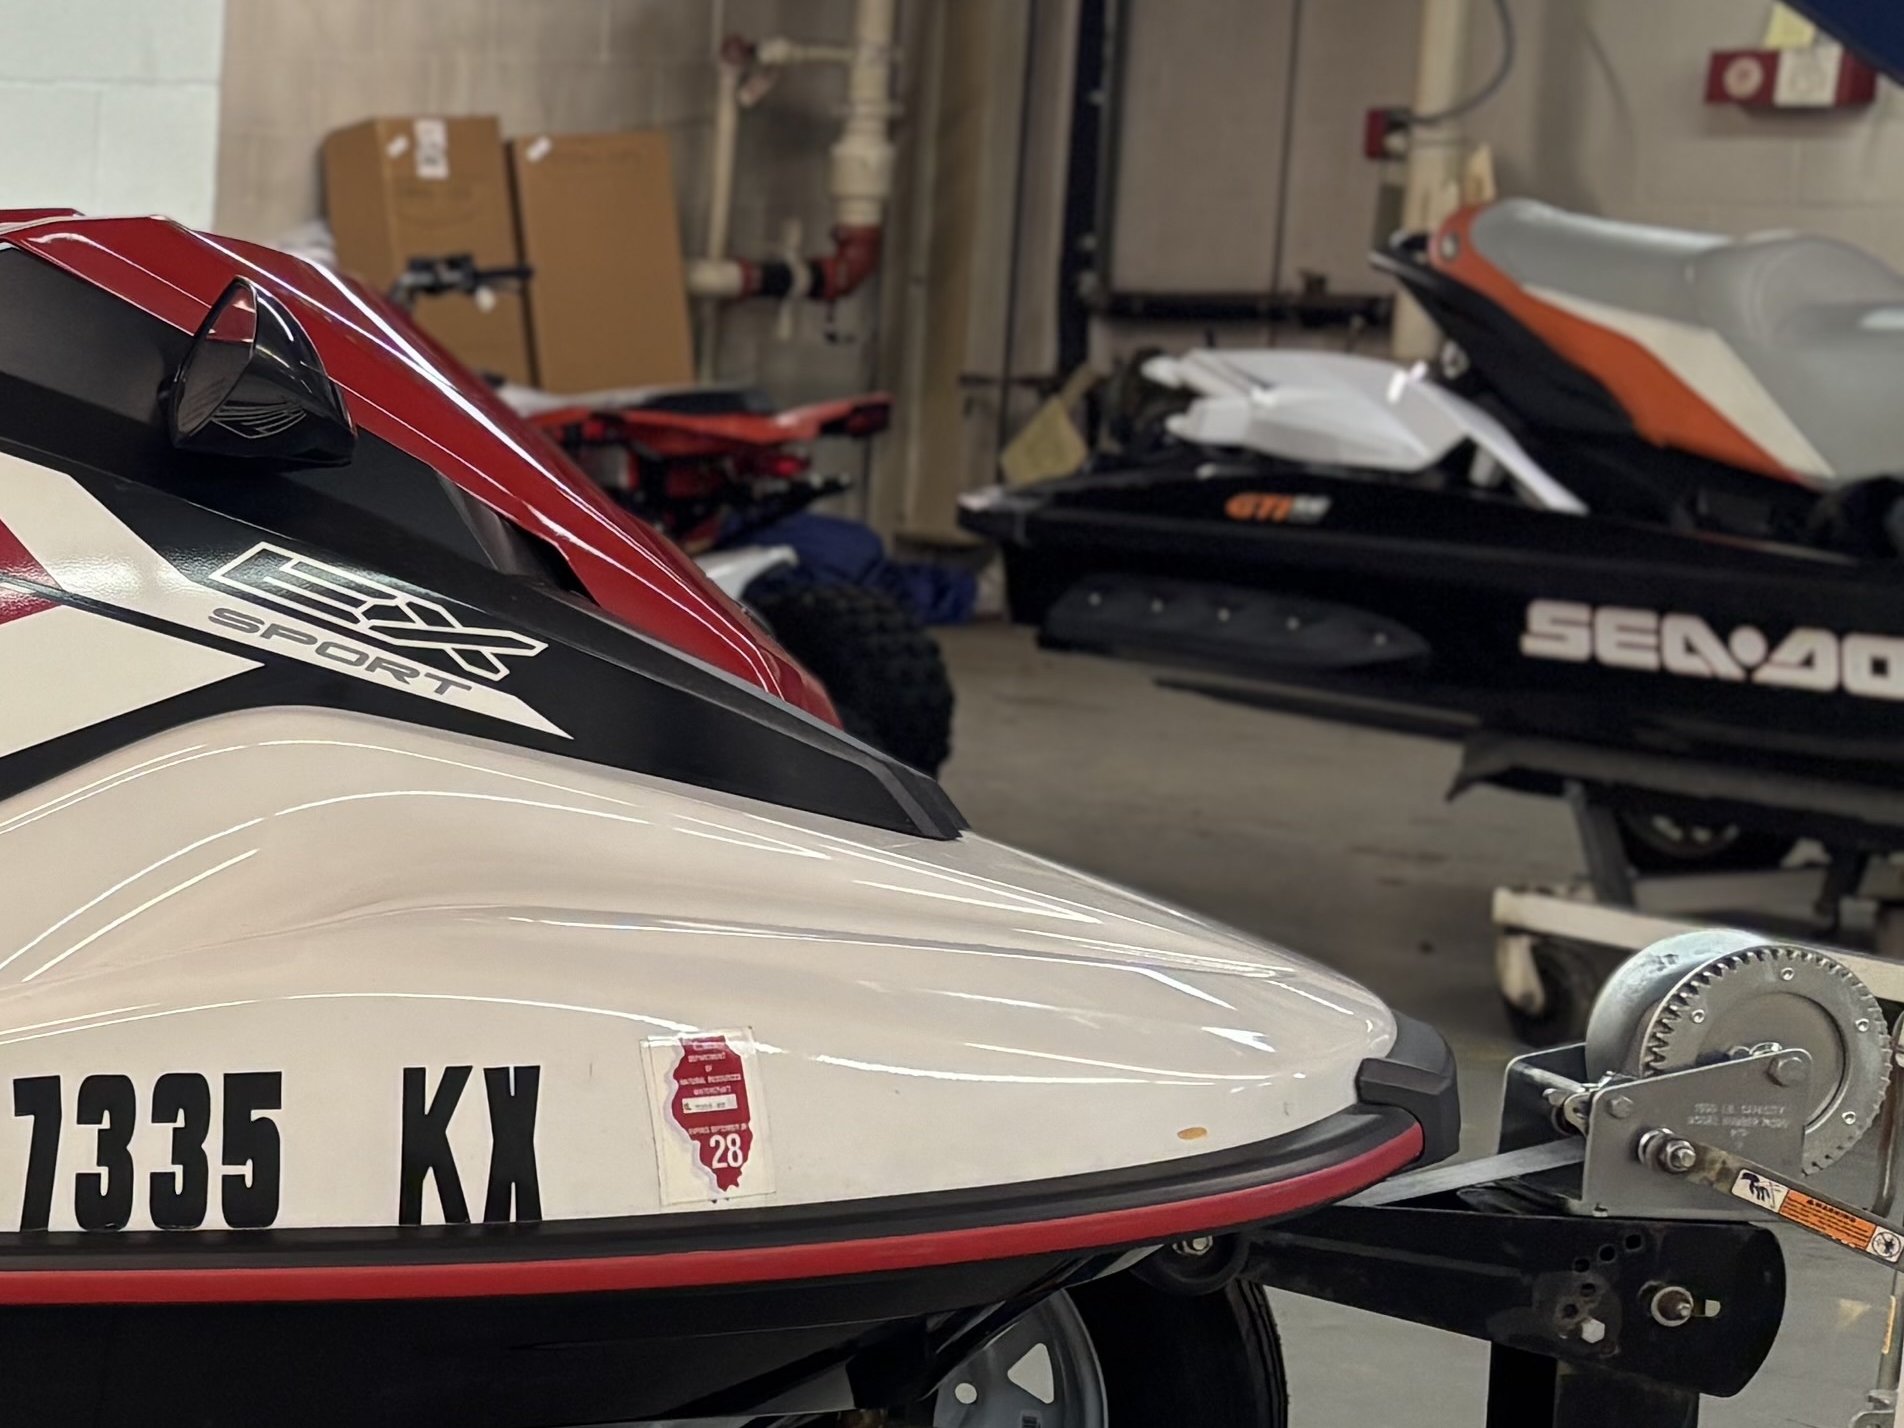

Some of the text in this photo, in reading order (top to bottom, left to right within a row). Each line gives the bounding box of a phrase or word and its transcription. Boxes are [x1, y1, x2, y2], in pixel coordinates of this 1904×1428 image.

[207, 541, 549, 682] EX
[208, 606, 473, 696] SPORT
[13, 1071, 283, 1233] 7335
[398, 1065, 543, 1226] KX
[709, 1133, 744, 1169] 28
